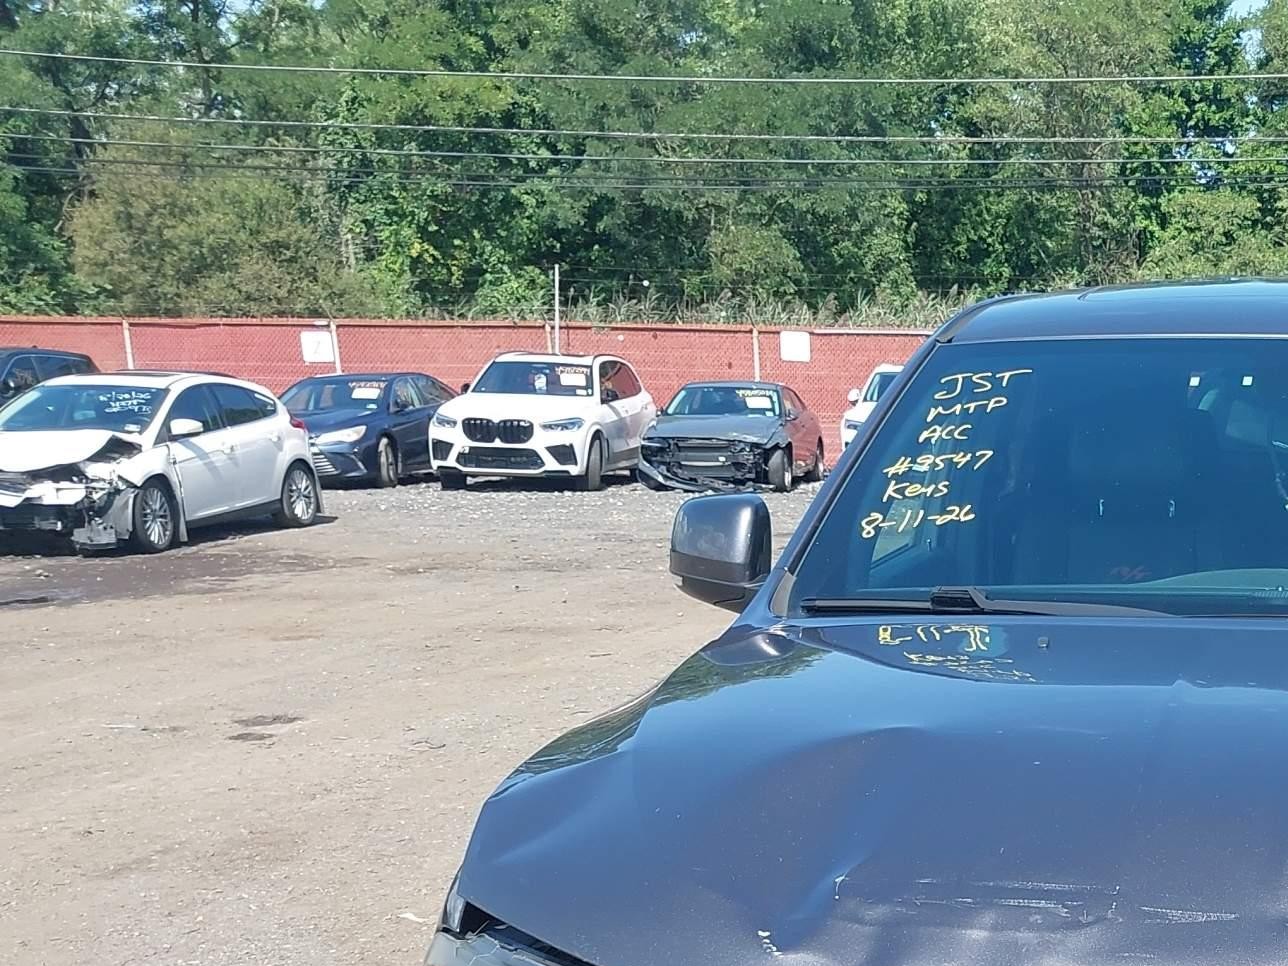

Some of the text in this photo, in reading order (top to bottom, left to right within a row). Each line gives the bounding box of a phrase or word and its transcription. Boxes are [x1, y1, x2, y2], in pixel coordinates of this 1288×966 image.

[934, 369, 1032, 399] JST
[926, 396, 1009, 423] MTP
[918, 424, 973, 444] ACC
[860, 504, 977, 540] 8-11-26
